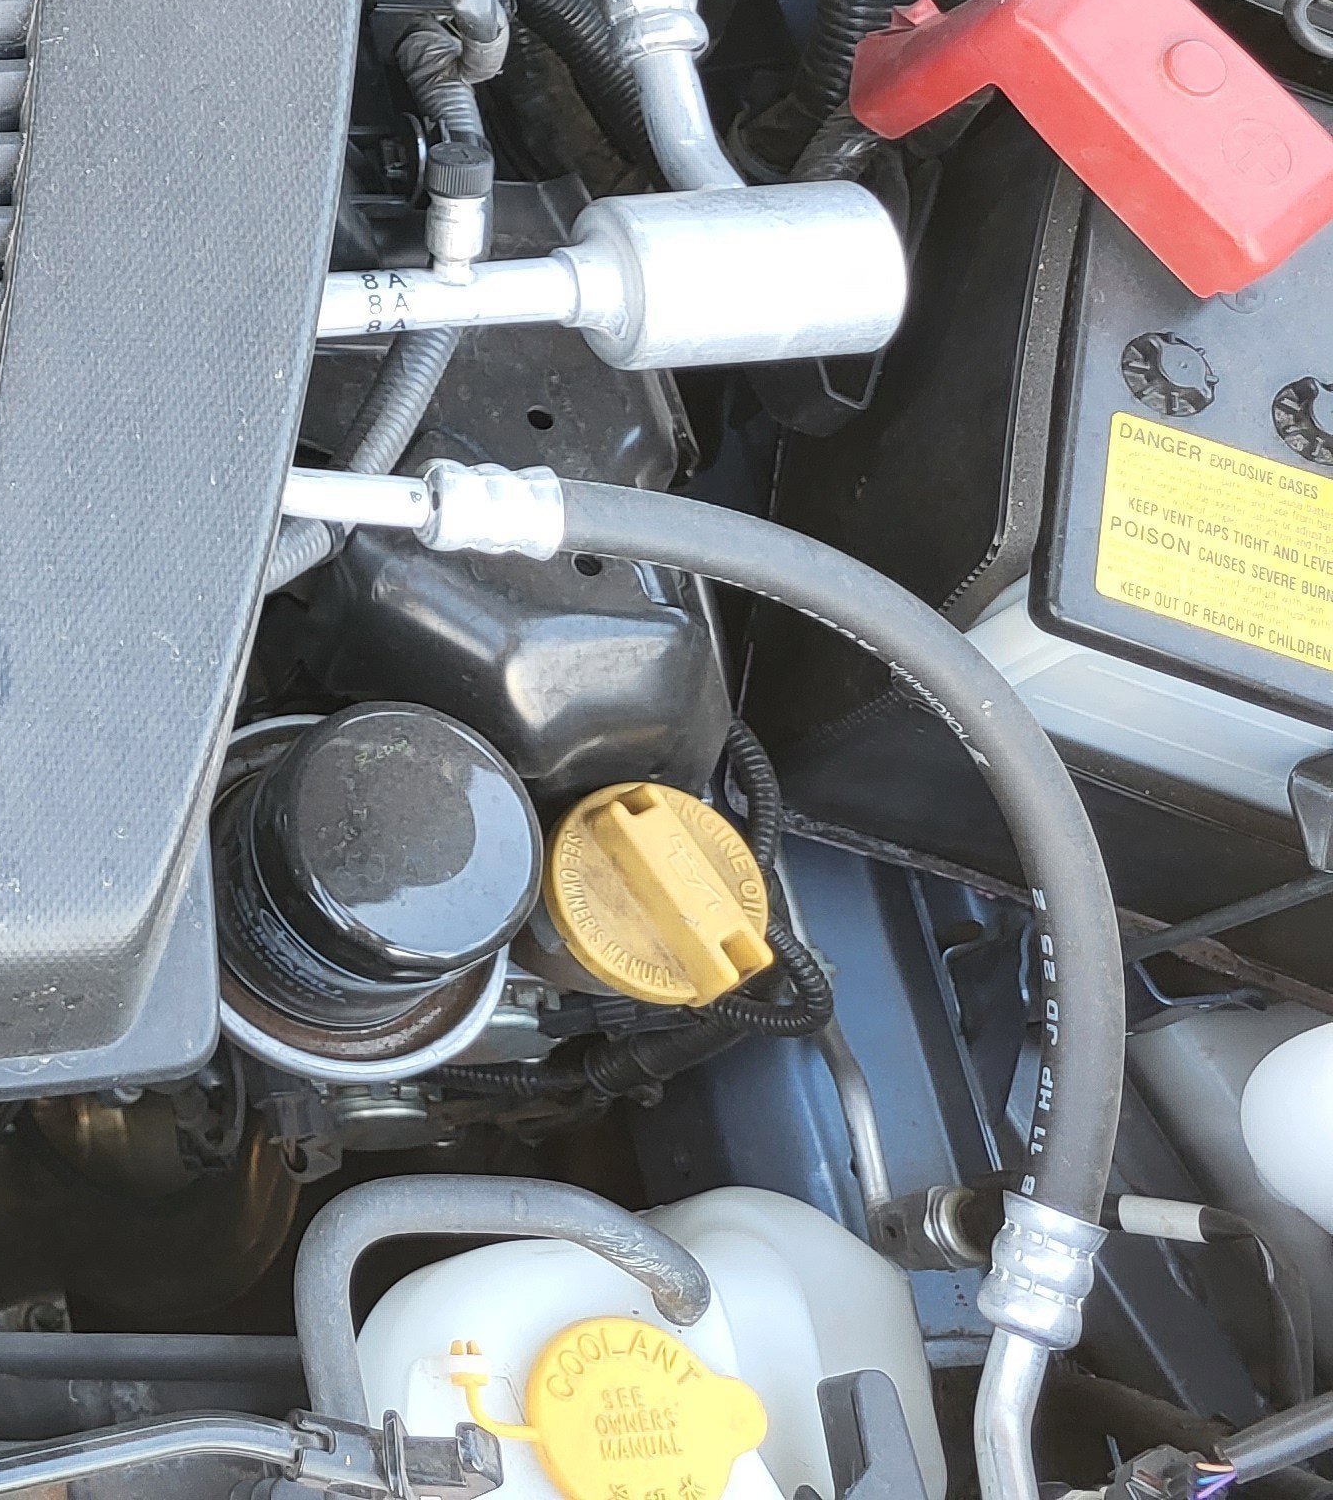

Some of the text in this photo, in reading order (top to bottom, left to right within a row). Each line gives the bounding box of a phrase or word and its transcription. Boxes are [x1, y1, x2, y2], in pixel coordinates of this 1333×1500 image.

[361, 272, 409, 291] 8 A
[368, 292, 410, 315] 8 A
[1119, 421, 1203, 463] DANGER
[1209, 452, 1274, 487] EXPLOSIVE
[1278, 475, 1319, 500] GASES
[1110, 515, 1192, 557] POISON
[1198, 546, 1247, 575] CAUSES
[1251, 563, 1297, 592] SEVERE
[1128, 496, 1159, 517] KEEP
[1162, 507, 1195, 528] VENT
[1197, 518, 1229, 542] CAPS
[1233, 529, 1271, 554] TIGHT
[1272, 543, 1299, 564] AND
[1120, 580, 1151, 601] KEEP
[1154, 591, 1180, 612] OUT
[1183, 601, 1199, 619] OF
[1203, 607, 1245, 634] REACH
[1248, 622, 1265, 640] OF
[1268, 629, 1333, 664] CHILDREN
[888, 660, 971, 740] YOKOHAMA
[663, 790, 764, 920] ENGINE OIL
[559, 829, 678, 990] SEE OWNER'S MANUAL
[1039, 933, 1057, 983] 25
[1046, 998, 1060, 1047] JD
[1037, 1066, 1054, 1112] HP
[1030, 1125, 1047, 1156] 11
[546, 1327, 702, 1399] COOLANT
[601, 1385, 646, 1410] SEE
[600, 1434, 684, 1462] MANUAL
